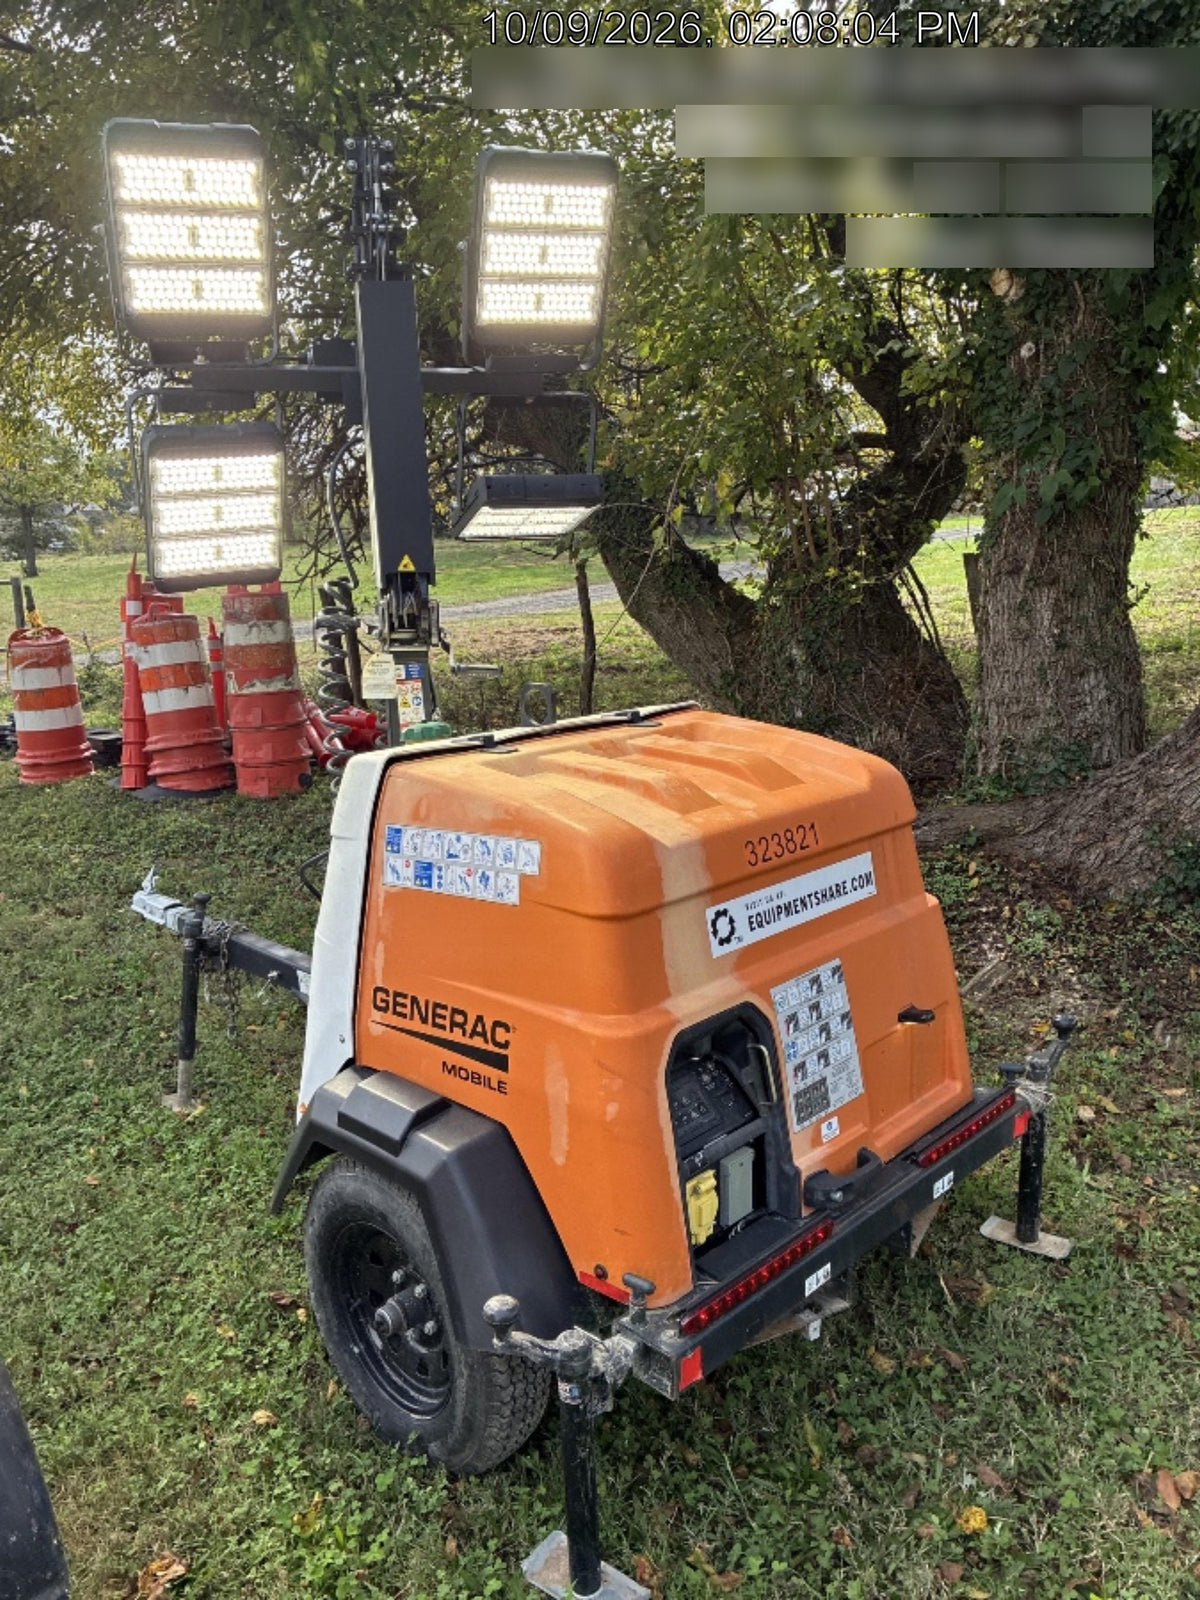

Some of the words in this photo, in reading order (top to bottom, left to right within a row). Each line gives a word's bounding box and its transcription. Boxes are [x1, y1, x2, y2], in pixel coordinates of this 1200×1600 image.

[744, 822, 820, 866] 323821
[748, 870, 874, 932] EQUIPMENTSHARE.COM
[372, 986, 511, 1050] GENERAC
[441, 1061, 508, 1095] MOBILE
